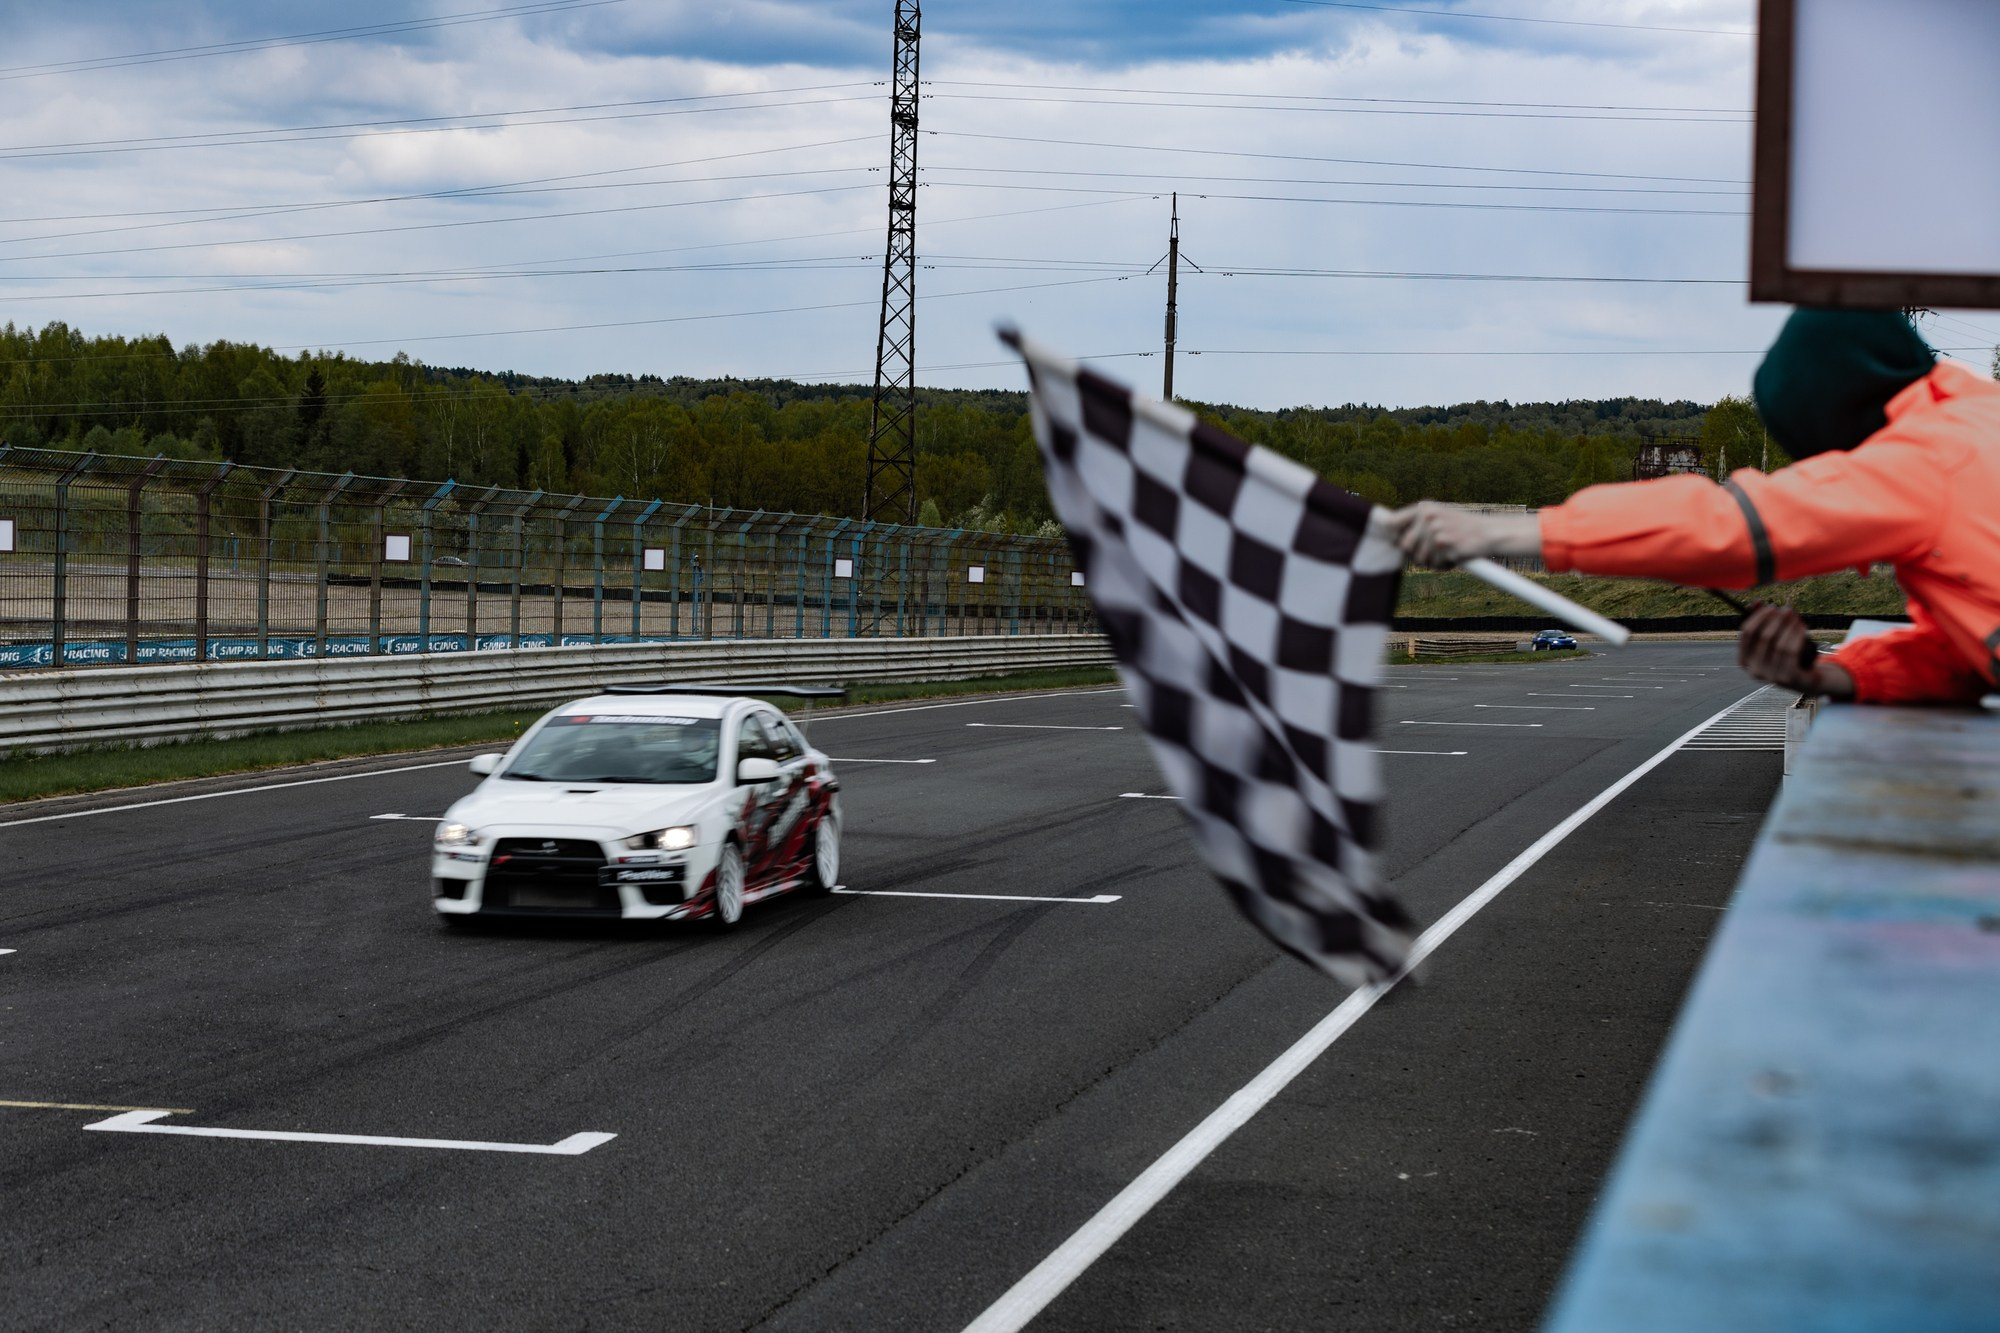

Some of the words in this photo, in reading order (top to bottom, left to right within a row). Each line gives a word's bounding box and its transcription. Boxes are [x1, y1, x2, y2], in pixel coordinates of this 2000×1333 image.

[158, 647, 196, 657] RACING
[220, 645, 244, 656] SMP
[244, 644, 283, 655] RANG
[331, 643, 370, 654] RACING
[394, 642, 418, 652] SMP
[428, 641, 458, 651] ACING
[68, 648, 110, 660] RACING
